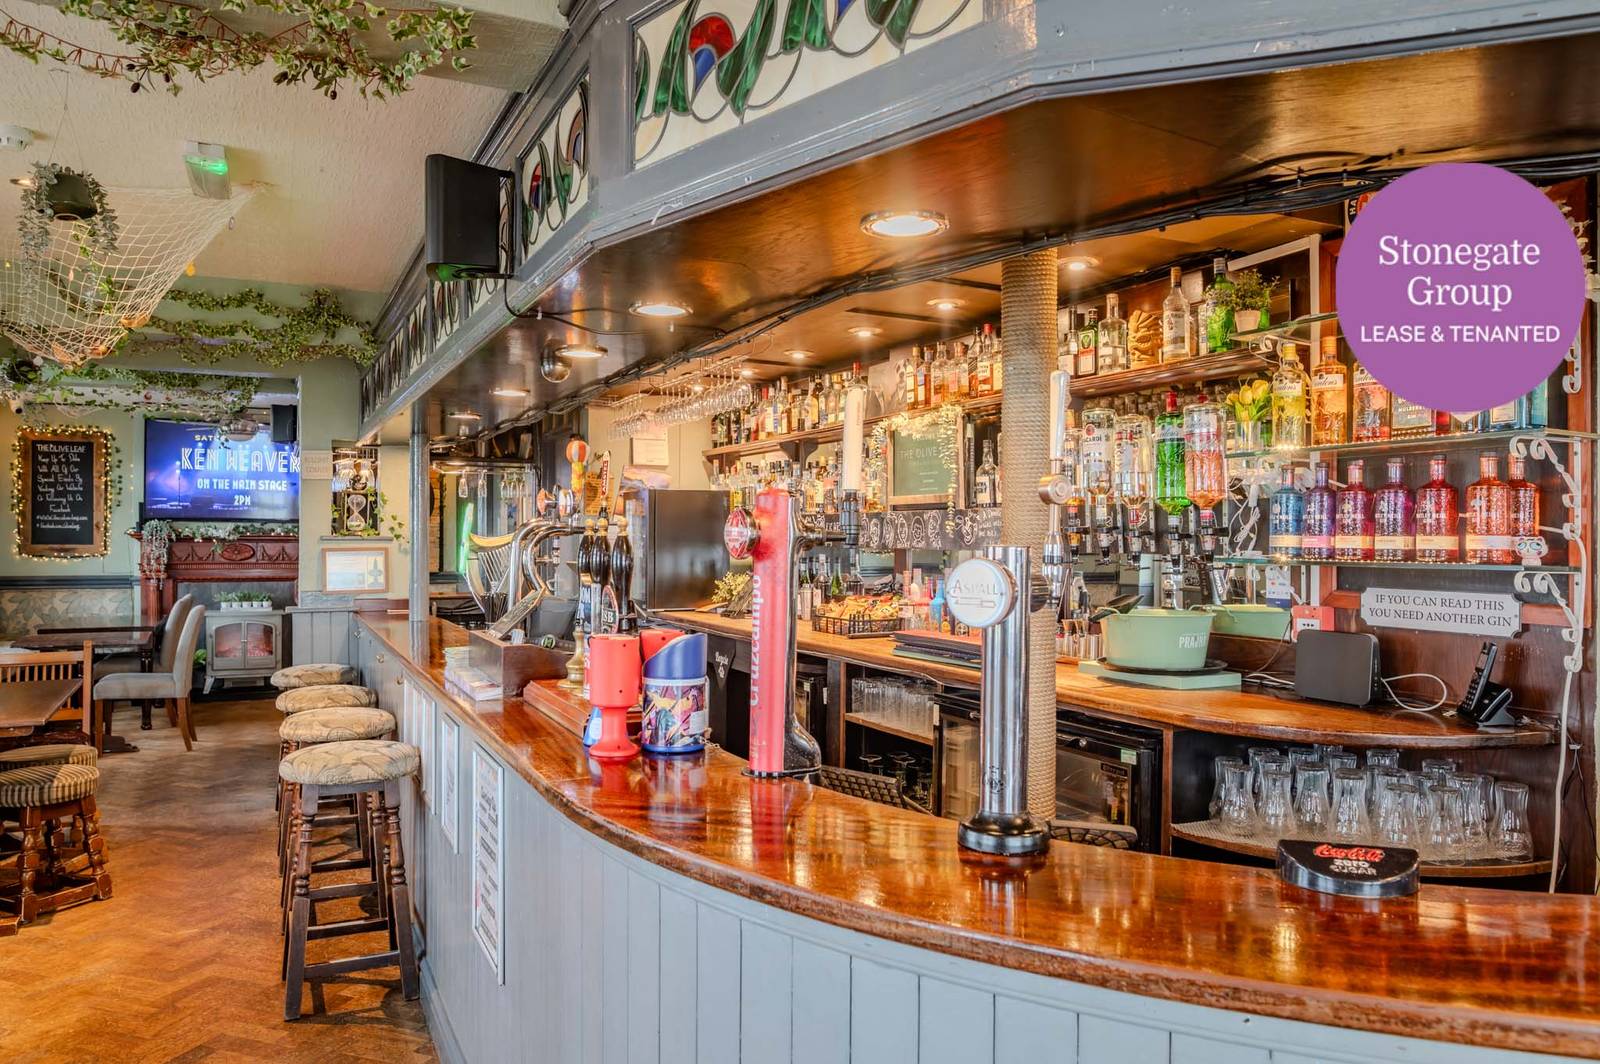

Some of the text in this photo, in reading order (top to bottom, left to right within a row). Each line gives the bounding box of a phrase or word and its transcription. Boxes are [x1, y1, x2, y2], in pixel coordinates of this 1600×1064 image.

[70, 444, 86, 454] LEAF
[181, 447, 221, 471] KEN
[226, 449, 300, 473] WEAVER
[197, 479, 288, 491] ON THE MAIN STAGE
[234, 495, 251, 506] 2PM
[1375, 593, 1504, 611] IF YOU CAN READ THIS
[1369, 607, 1512, 627] YOU NEED ANOTHER GIN
[1329, 864, 1377, 876] SUGAR
